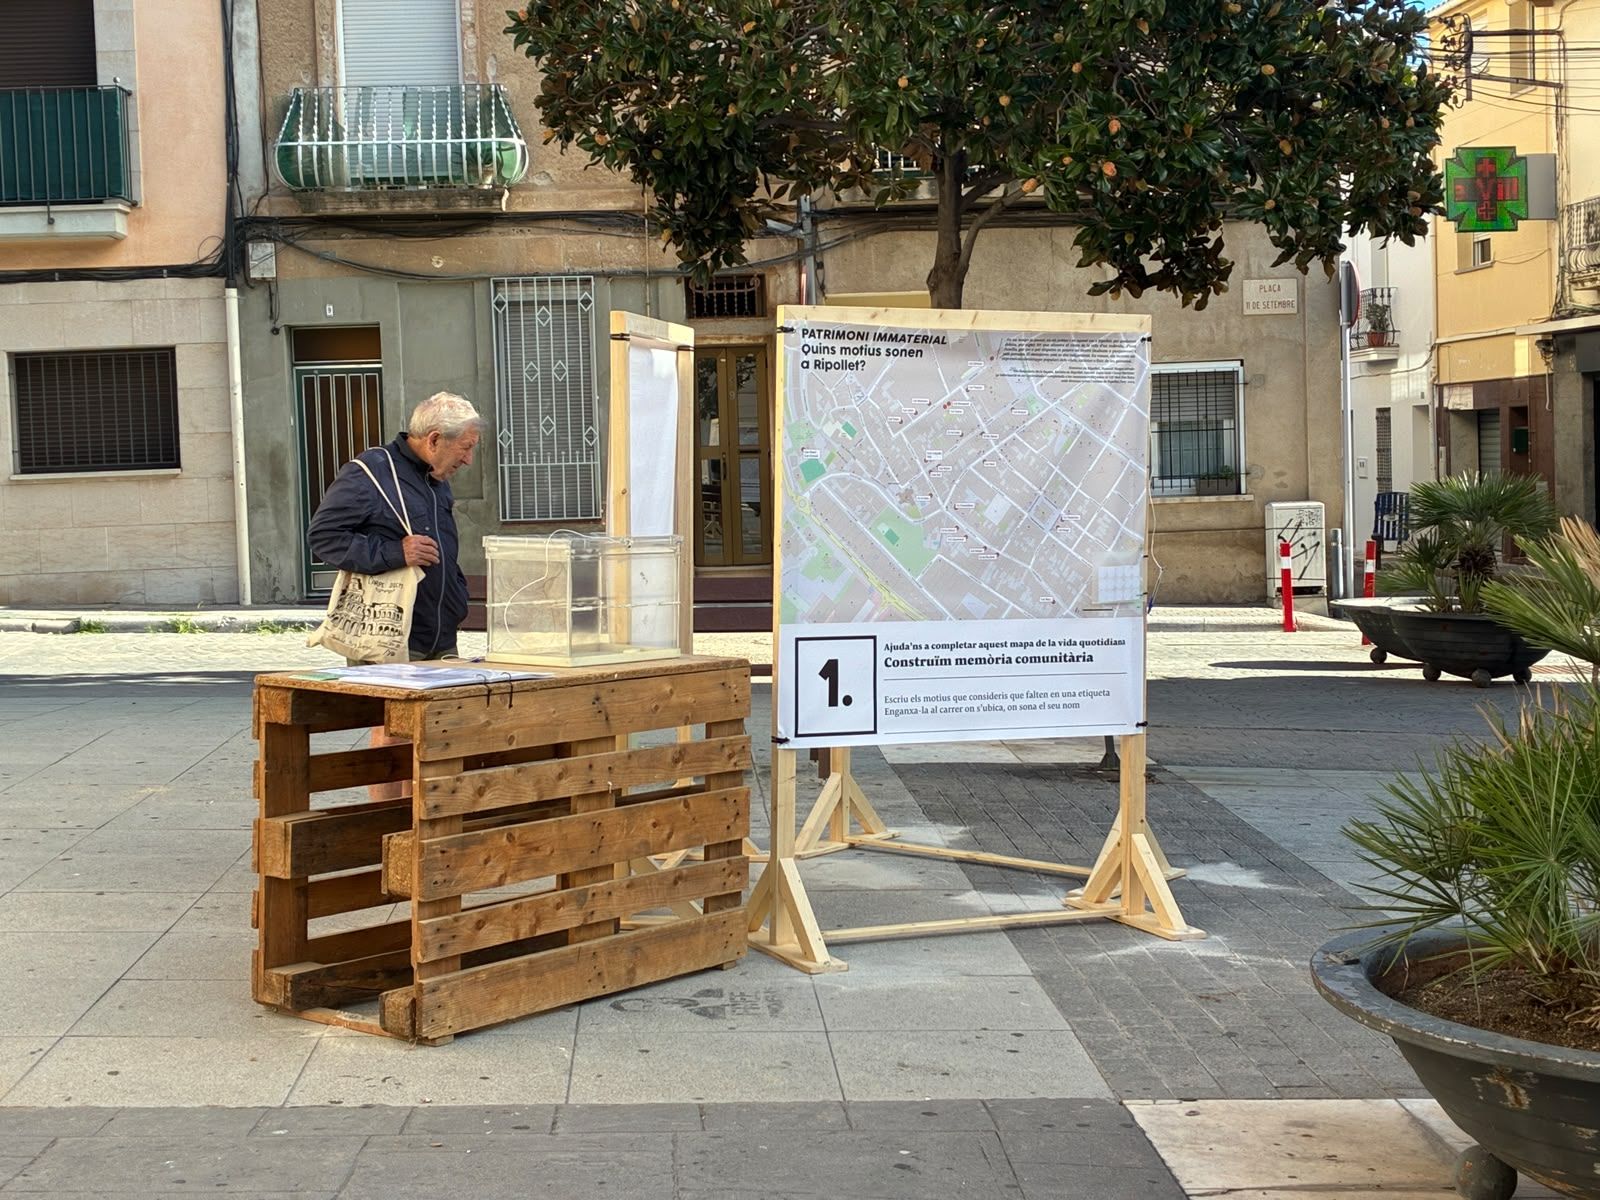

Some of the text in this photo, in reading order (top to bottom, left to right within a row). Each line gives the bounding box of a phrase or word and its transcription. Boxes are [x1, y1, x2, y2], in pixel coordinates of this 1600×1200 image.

[1259, 284, 1281, 293] PLAÇA
[1252, 302, 1260, 310] DE
[1262, 300, 1295, 309] SETEMBRE
[801, 328, 948, 345] PATRIMONI IMMATERIAL
[801, 343, 923, 358] Quins motius sonen
[801, 358, 866, 372] a Ripollet?
[884, 642, 922, 653] Ajuda'ns
[931, 641, 977, 652] completar
[978, 640, 1008, 651] aquest
[1010, 640, 1034, 650] mapa
[1036, 639, 1046, 647] de
[1048, 639, 1056, 647] la
[1058, 638, 1077, 647] vida
[884, 651, 1093, 668] Construïm memòria comunitària
[818, 658, 853, 708] 1.
[884, 695, 909, 704] Escriu
[911, 694, 921, 703] els
[923, 693, 951, 703] motius
[953, 694, 967, 704] que
[969, 692, 1008, 701] consideris
[1010, 692, 1024, 701] que
[1026, 690, 1048, 700] falten
[1062, 690, 1076, 698] una
[1078, 689, 1110, 699] etiqueta
[884, 705, 929, 717] Enganxa-la
[931, 705, 938, 714] al
[940, 706, 963, 714] carrer
[977, 704, 1006, 713] s'ubica,
[1007, 704, 1017, 712] on
[1019, 703, 1037, 711] sona
[1039, 702, 1046, 710] el
[1047, 702, 1060, 710] seu
[1062, 702, 1080, 710] nom
